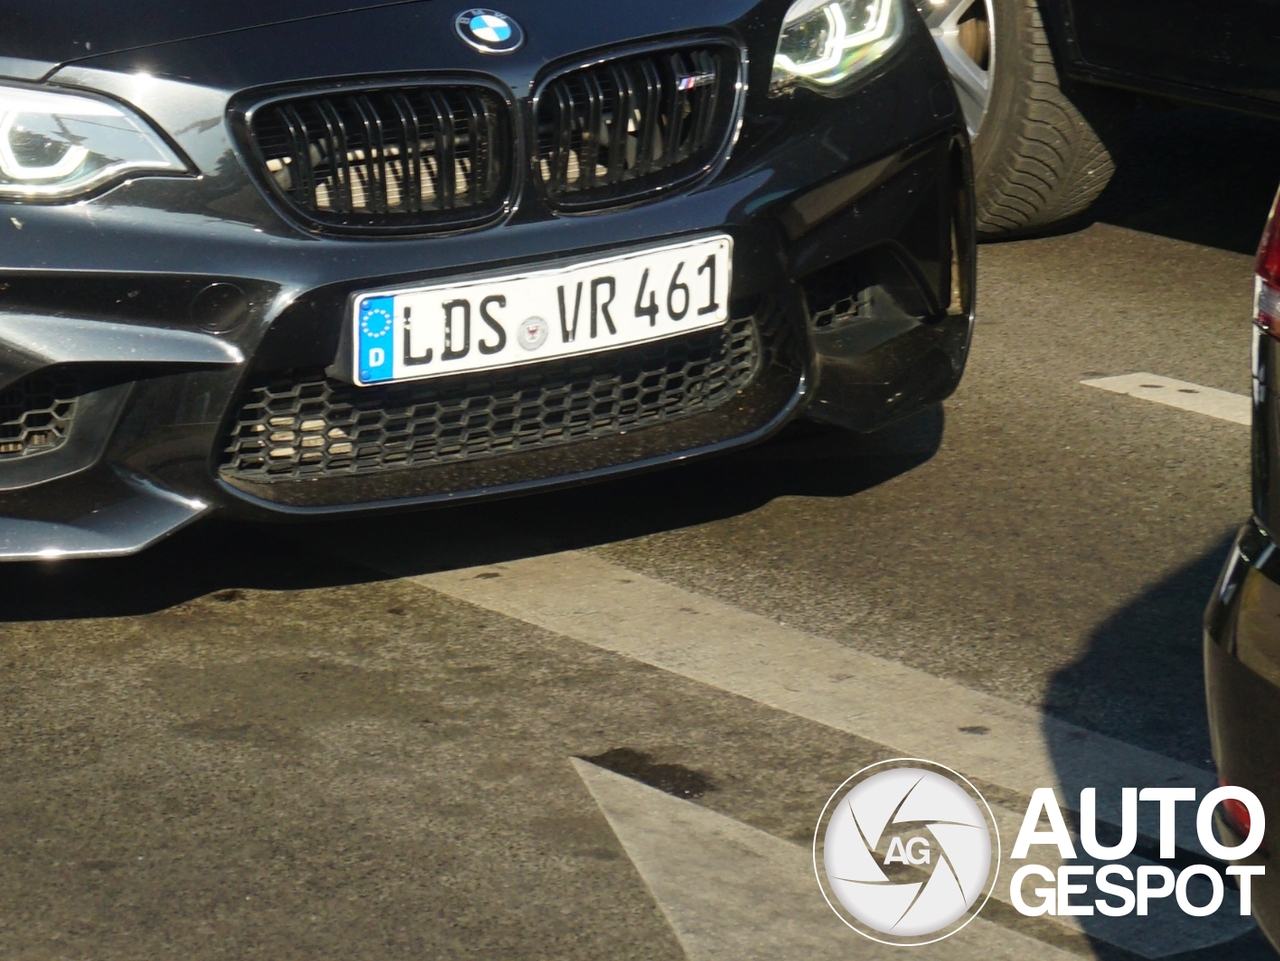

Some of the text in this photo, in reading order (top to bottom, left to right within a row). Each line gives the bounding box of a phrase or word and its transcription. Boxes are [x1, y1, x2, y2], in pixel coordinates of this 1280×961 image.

[402, 253, 721, 367] LDS VR 461
[368, 347, 385, 368] D
